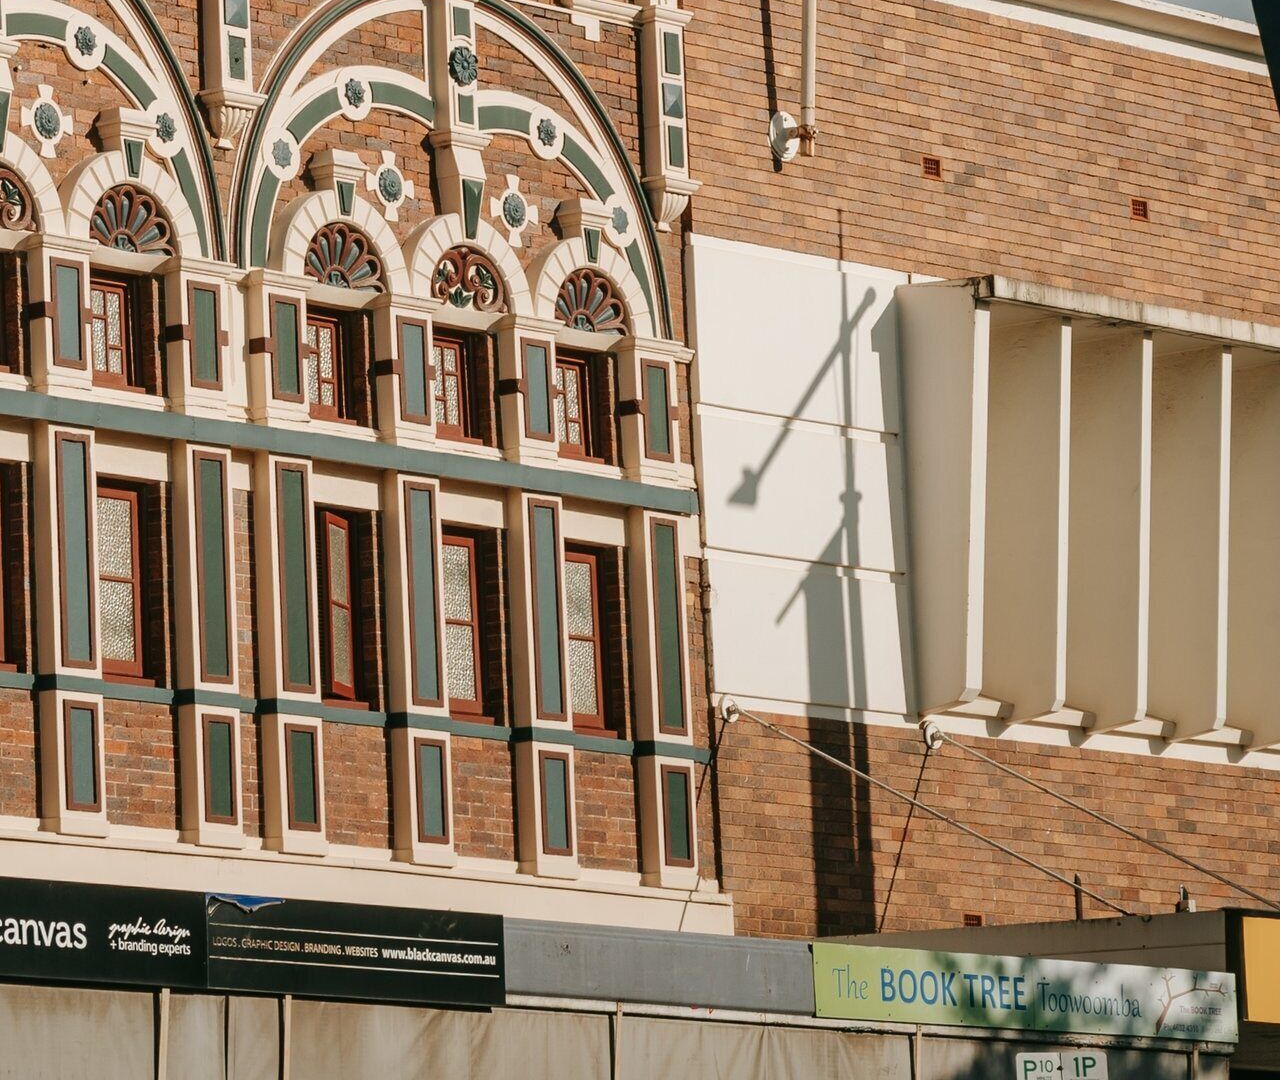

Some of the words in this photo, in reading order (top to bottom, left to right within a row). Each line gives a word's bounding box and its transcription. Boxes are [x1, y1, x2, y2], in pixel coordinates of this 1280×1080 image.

[118, 937, 158, 956] branding
[158, 943, 191, 957] experts
[212, 936, 238, 948] LOGOS
[241, 938, 274, 951] GRAPHIC
[274, 940, 301, 952] DESIGN
[304, 943, 342, 956] BRANDING
[344, 945, 379, 959] WEBSITES
[381, 947, 497, 966] www.blackcanvas.com.au
[831, 967, 870, 1001] The
[880, 967, 958, 1007] BOOK
[963, 973, 1027, 1011] TREE
[1036, 981, 1143, 1019] Toowoomba
[1040, 1060, 1053, 1073] 10
[1073, 1057, 1097, 1077] 1P
